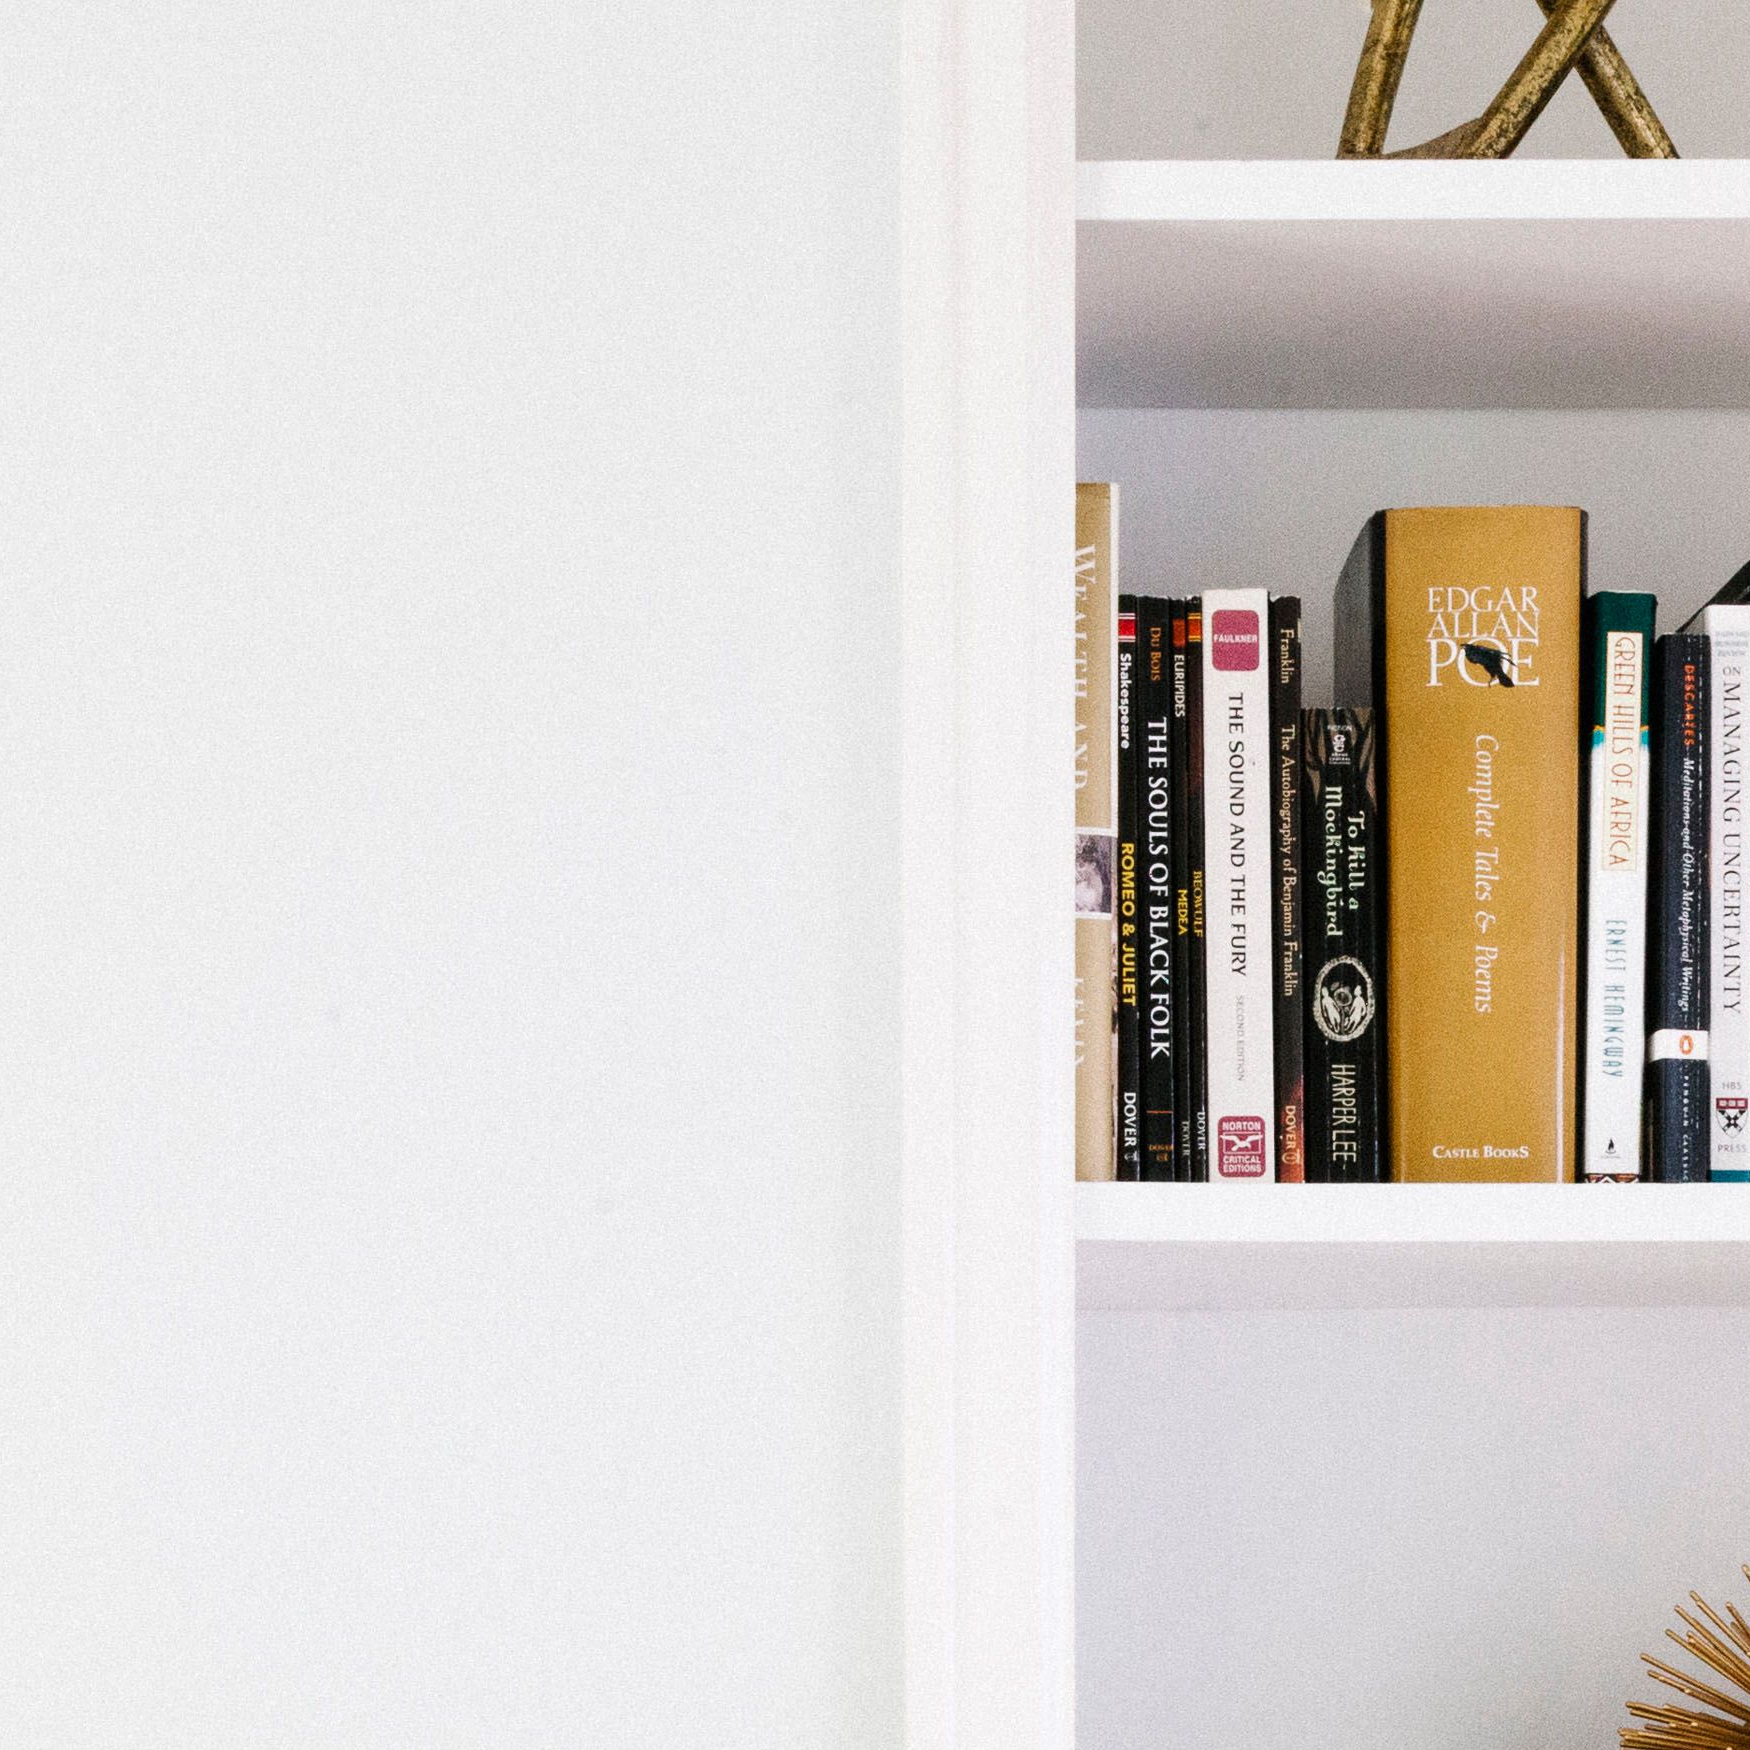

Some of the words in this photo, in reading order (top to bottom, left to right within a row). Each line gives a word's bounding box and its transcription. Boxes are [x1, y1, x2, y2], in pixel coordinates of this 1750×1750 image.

[1428, 586, 1539, 613] EDGAR
[1428, 612, 1539, 638] ALLAN
[1426, 638, 1540, 687] POE
[1615, 637, 1635, 694] GREEN
[1120, 653, 1131, 749] Shakespeare
[1228, 693, 1243, 734] THE
[1148, 717, 1167, 768] THE
[1613, 705, 1634, 755] HILLS
[1723, 684, 1741, 822] MANAGING
[1228, 742, 1244, 817] SOUND
[1468, 733, 1499, 837] Complete
[1612, 764, 1632, 788] OF
[1148, 777, 1168, 855] SOULS
[1348, 811, 1365, 838] To
[1610, 797, 1632, 866] AFRICA
[1230, 823, 1245, 868] AND
[1317, 786, 1342, 936] Mockingbird
[1121, 843, 1135, 916] ROMEO
[1149, 861, 1169, 896] OF
[1230, 875, 1245, 916] THE
[1475, 847, 1499, 901] Tales
[1122, 924, 1135, 937] &
[1349, 897, 1359, 910] a
[1475, 910, 1496, 933] &
[1723, 833, 1741, 1014] UNCERTAINTY
[1150, 908, 1169, 985] BLACK
[1230, 923, 1247, 977] FURY
[1606, 920, 1627, 971] ERNEST
[1122, 944, 1137, 1006] JULIET
[1475, 944, 1499, 1013] Poems
[1151, 993, 1170, 1059] FOLK
[1603, 985, 1625, 1078] HEMINGWAY
[1331, 1064, 1356, 1125] HARPER
[1333, 1129, 1356, 1163] LEE
